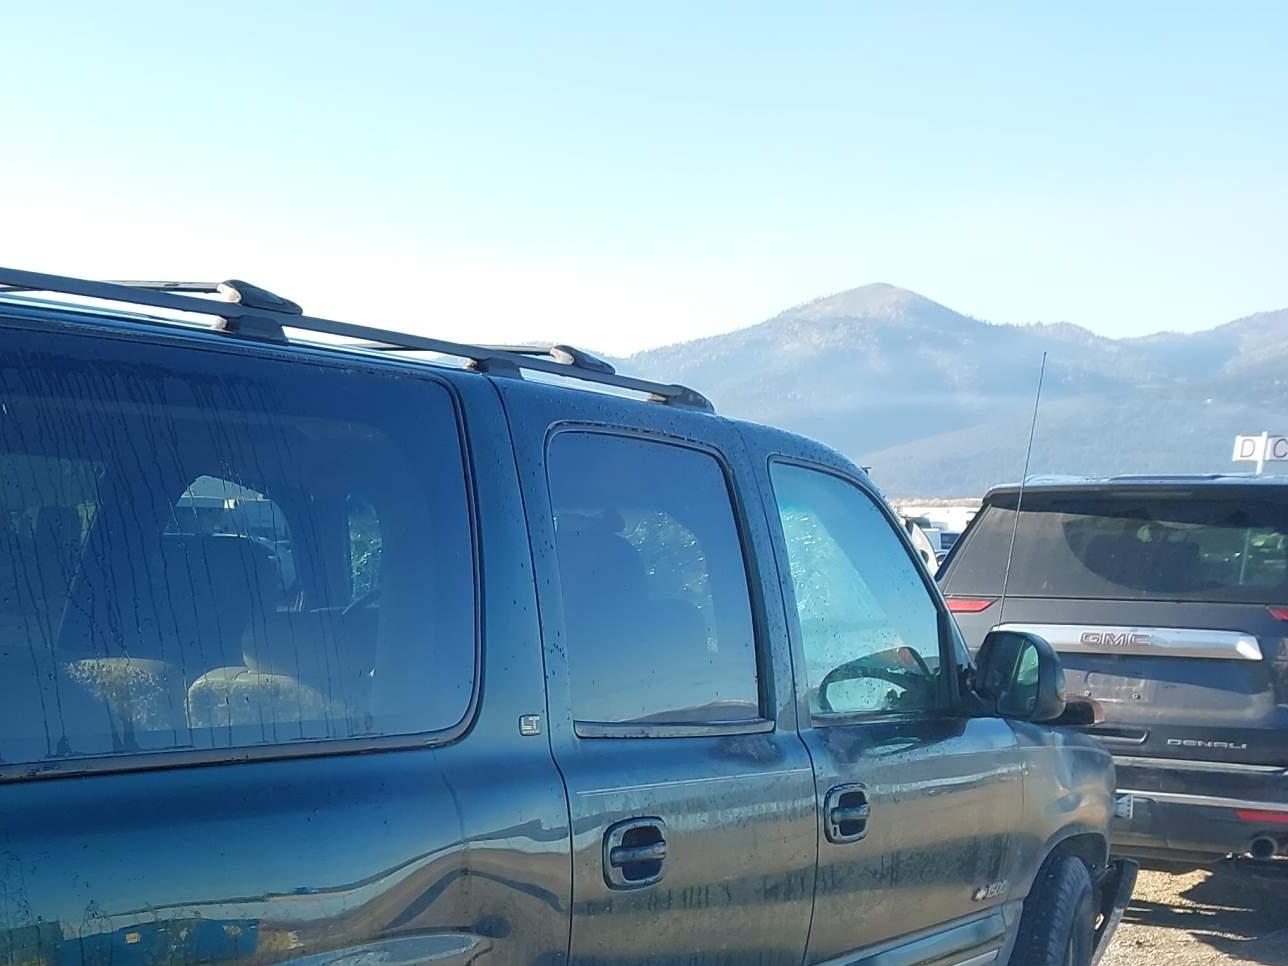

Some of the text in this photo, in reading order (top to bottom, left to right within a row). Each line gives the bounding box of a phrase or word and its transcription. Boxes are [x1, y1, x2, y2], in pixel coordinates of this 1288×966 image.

[1240, 438, 1256, 458] D
[1273, 438, 1288, 459] C
[1080, 632, 1152, 648] GMC
[1167, 738, 1248, 749] DENALI
